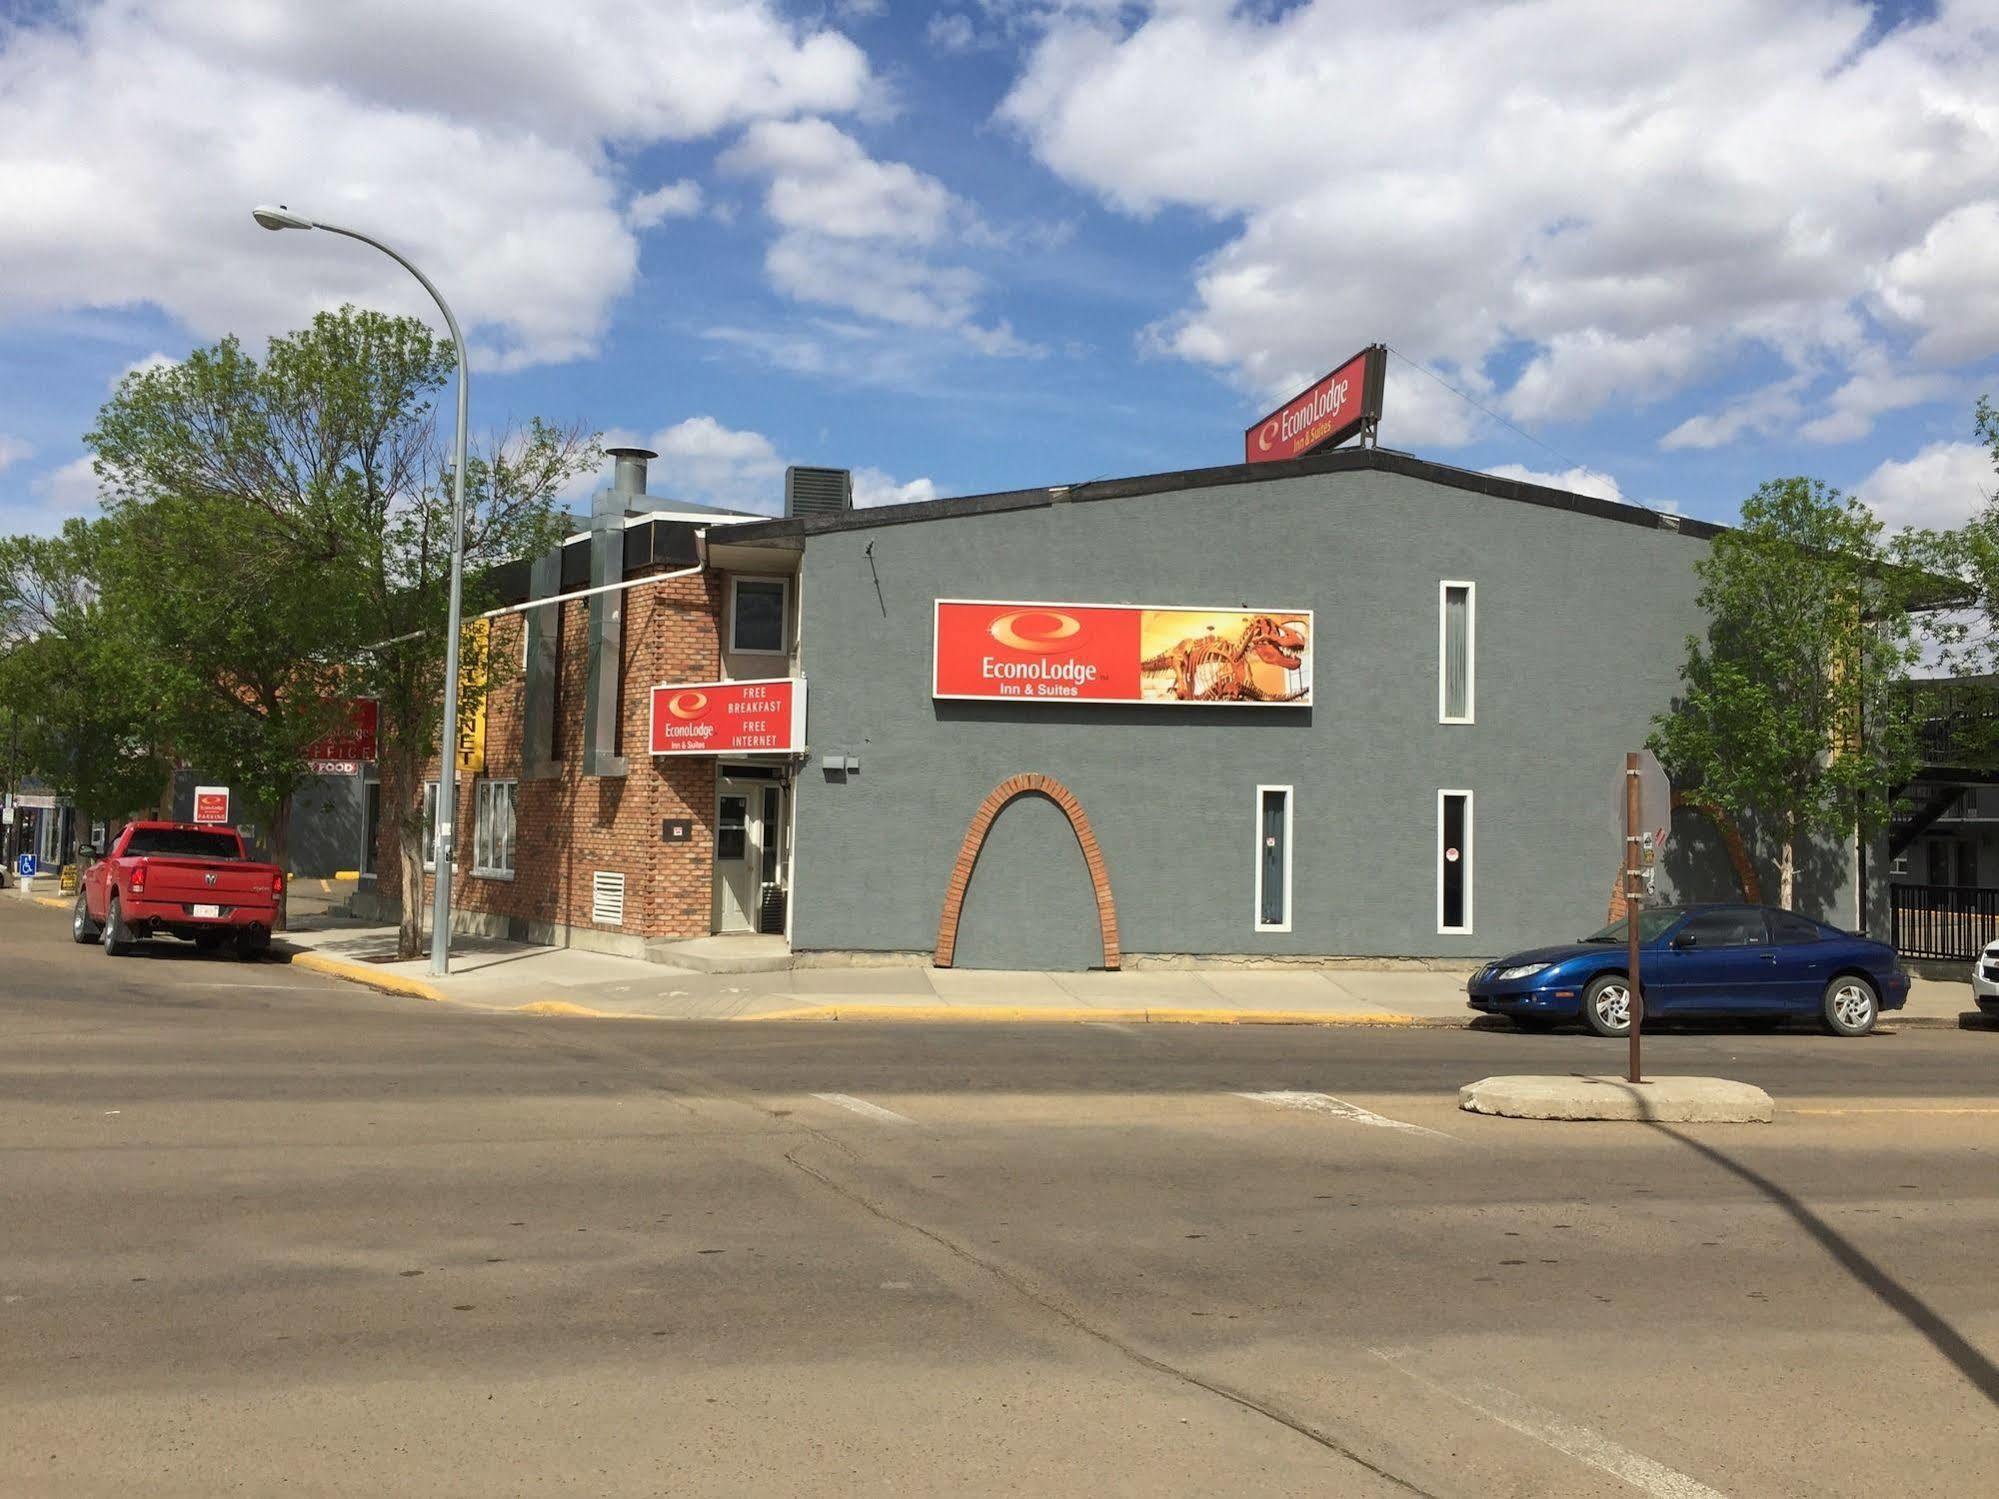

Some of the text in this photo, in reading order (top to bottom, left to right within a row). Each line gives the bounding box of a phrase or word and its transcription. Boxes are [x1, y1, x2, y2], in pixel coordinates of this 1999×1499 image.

[1281, 378, 1349, 442] EconoLodge
[983, 657, 1096, 685] EconoLodge
[743, 687, 766, 698] FREE
[1000, 683, 1079, 697] Inn & Suites
[728, 700, 782, 714] BREAKFAST
[665, 722, 714, 739] EconoLodge
[743, 720, 766, 732] FREE
[671, 741, 681, 749] Inn
[687, 741, 705, 749] Suites
[732, 735, 777, 747] INTERNET
[319, 763, 352, 773] FOOD
